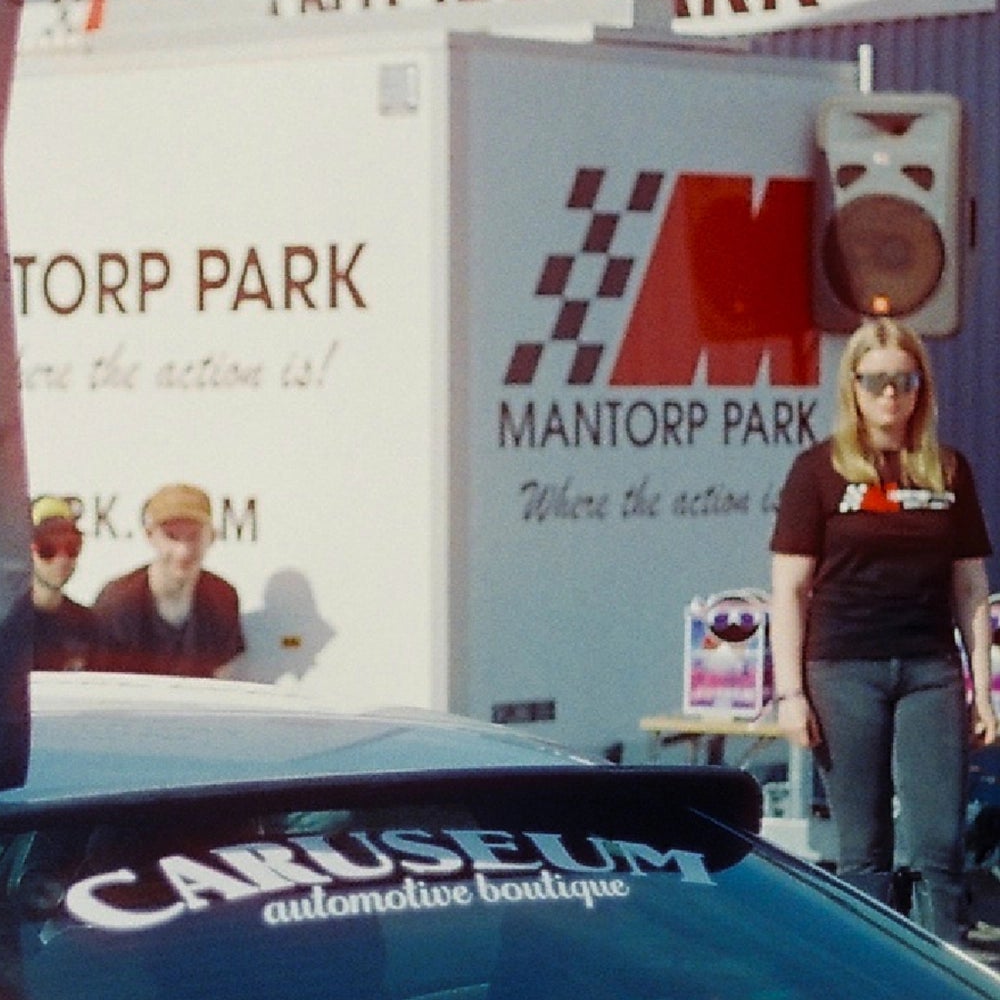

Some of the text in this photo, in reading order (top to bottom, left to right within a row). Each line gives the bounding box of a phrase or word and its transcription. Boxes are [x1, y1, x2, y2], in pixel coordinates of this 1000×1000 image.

[13, 242, 367, 315] TORP PARK
[88, 340, 142, 390] the
[155, 350, 261, 390] action
[281, 339, 340, 390] is!
[499, 400, 819, 448] MANTORP PARK
[520, 475, 607, 522] Where
[622, 474, 664, 519] the
[674, 482, 750, 518] action
[65, 829, 716, 932] CARUSEUM
[262, 868, 630, 926] automotive boutique
